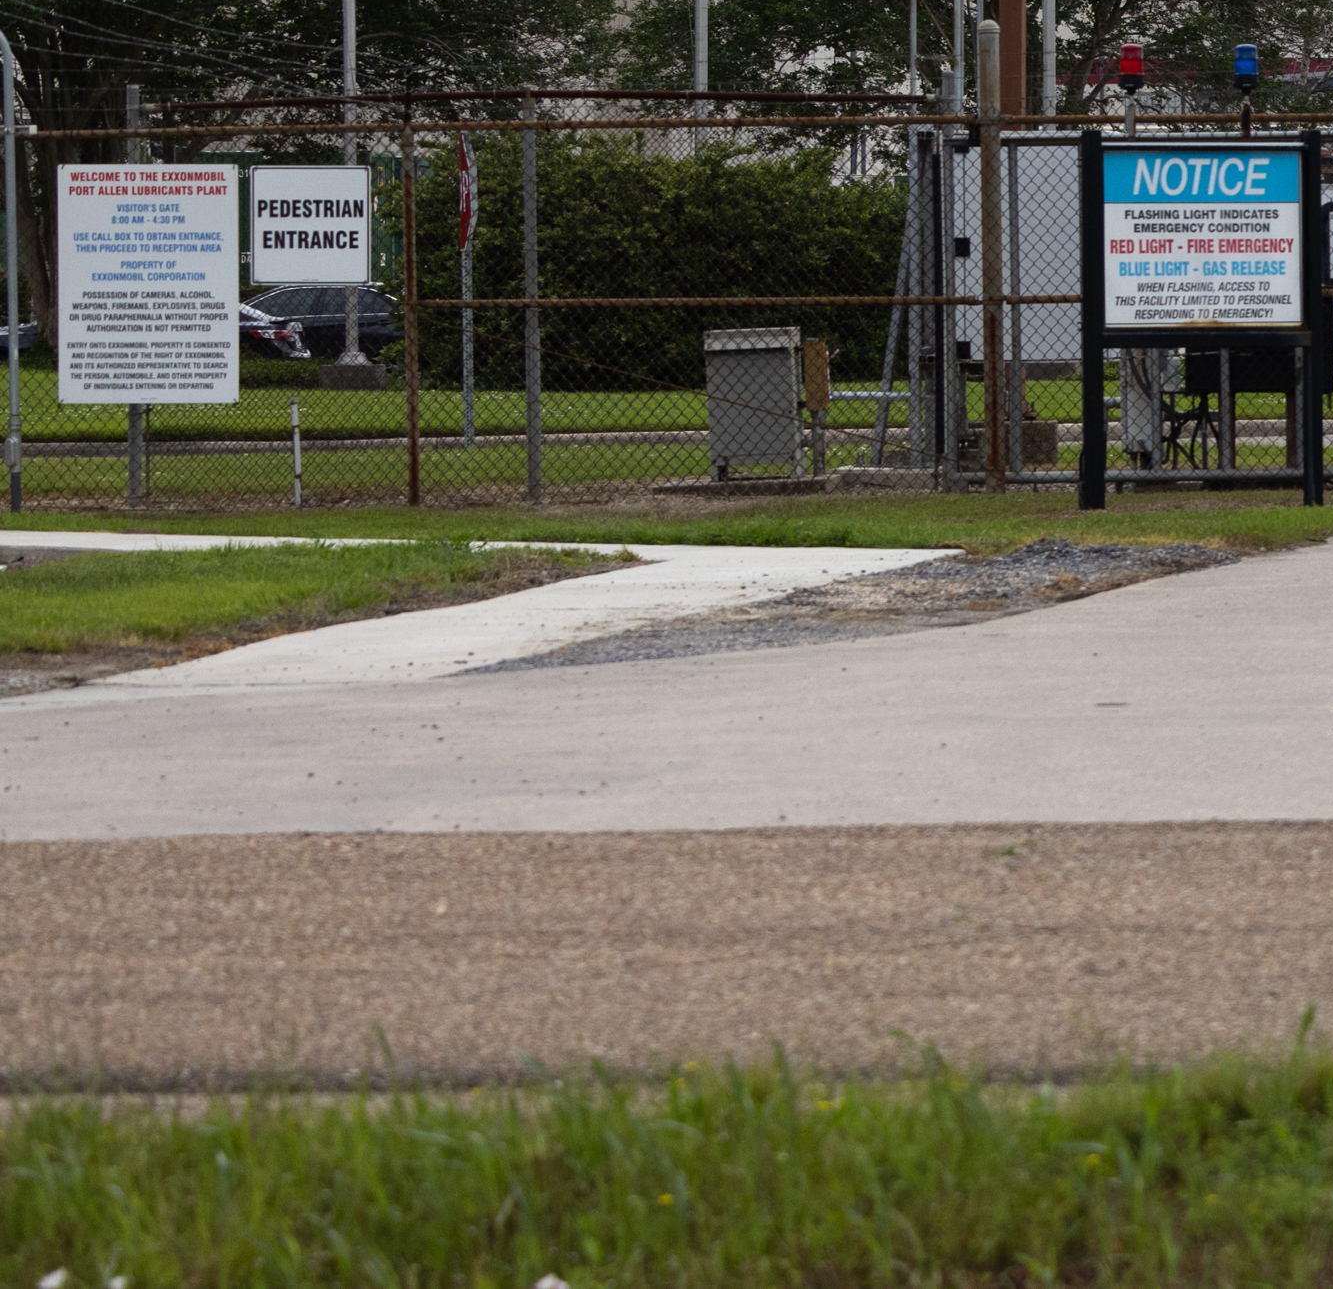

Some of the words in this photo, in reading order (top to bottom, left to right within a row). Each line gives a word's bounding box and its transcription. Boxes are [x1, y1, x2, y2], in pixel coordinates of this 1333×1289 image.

[70, 172, 120, 181] WELCOME
[123, 172, 137, 181] TO
[139, 172, 158, 181] THE
[161, 172, 226, 181] EXXONMOBIL
[1133, 157, 1271, 196] NOTICE
[69, 186, 95, 195] PORT
[98, 186, 128, 195] ALLEN
[131, 186, 193, 195] LUBRICANTS
[196, 186, 227, 195] PLANT
[116, 204, 157, 212] VISITOR'S
[159, 204, 180, 212] GATE
[257, 200, 364, 217] PEDESTRIAN
[1124, 210, 1180, 219] FLASHING
[1183, 210, 1216, 219] LIGHT
[1220, 210, 1279, 219] INDICATES
[111, 216, 130, 224] 8:00
[152, 216, 171, 224] 4:30
[1133, 223, 1204, 233] EMERGENCY
[1208, 223, 1270, 232] CONDITION
[73, 233, 89, 241] USE
[91, 233, 112, 241] CALL
[114, 232, 131, 241] BOX
[133, 232, 145, 241] TO
[146, 232, 177, 241] OBTAIN
[178, 232, 224, 242] ENTRANCE,
[262, 231, 359, 249] ENTRANCE
[75, 244, 97, 252] THEN
[99, 244, 137, 252] PROCEED
[139, 244, 150, 252] TO
[152, 244, 198, 252] RECEPTION
[199, 244, 222, 252] AREA
[1110, 239, 1135, 254] RED
[1139, 239, 1174, 254] LIGHT
[1187, 239, 1214, 253] FIRE
[1218, 239, 1294, 253] EMERGENCY
[120, 261, 164, 269] PROPERTY
[165, 261, 177, 269] OF
[1119, 262, 1150, 276] BLUE
[1154, 261, 1189, 276] LIGHT
[1202, 261, 1228, 276] GAS
[1231, 261, 1286, 275] RELEASE
[91, 273, 145, 281] EXXONMOBIL
[147, 272, 206, 281] CORPORATION
[1137, 282, 1165, 292] WHEN
[1167, 282, 1215, 292] FLASHING,
[1217, 282, 1256, 291] ACCESS
[1258, 281, 1270, 291] TO
[1115, 296, 1136, 306] THIS
[1138, 296, 1180, 306] FACILITY
[1182, 295, 1220, 305] LIMITED
[1223, 295, 1236, 305] TO
[1237, 295, 1292, 305] PERSONNEL
[1134, 309, 1195, 319] RESPONDING
[1198, 309, 1210, 319] TO
[1212, 308, 1273, 319] EMERGENCY!
